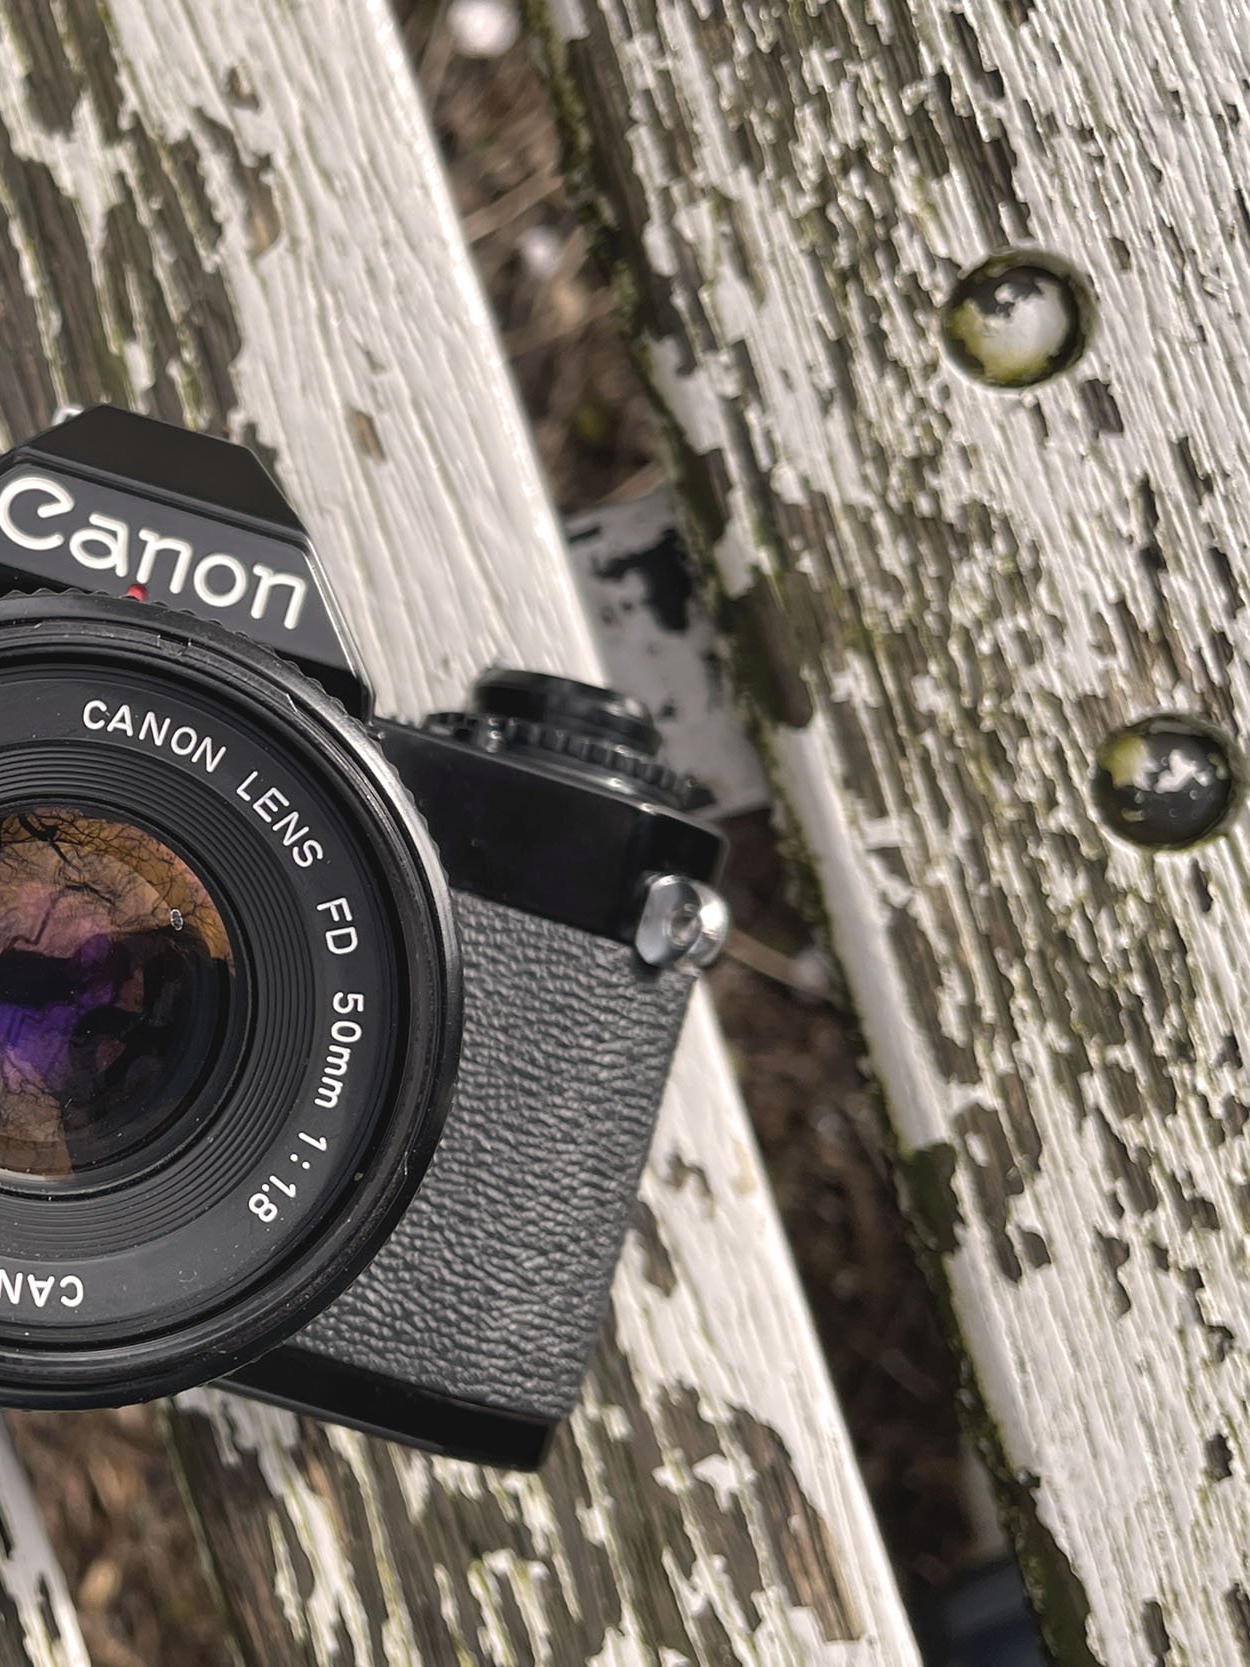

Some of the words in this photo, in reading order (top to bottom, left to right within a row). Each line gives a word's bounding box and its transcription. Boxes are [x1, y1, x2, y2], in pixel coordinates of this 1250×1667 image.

[82, 700, 227, 773] CANON
[236, 771, 324, 868] LENS
[316, 897, 358, 955] FD
[314, 991, 364, 1109] 50mm
